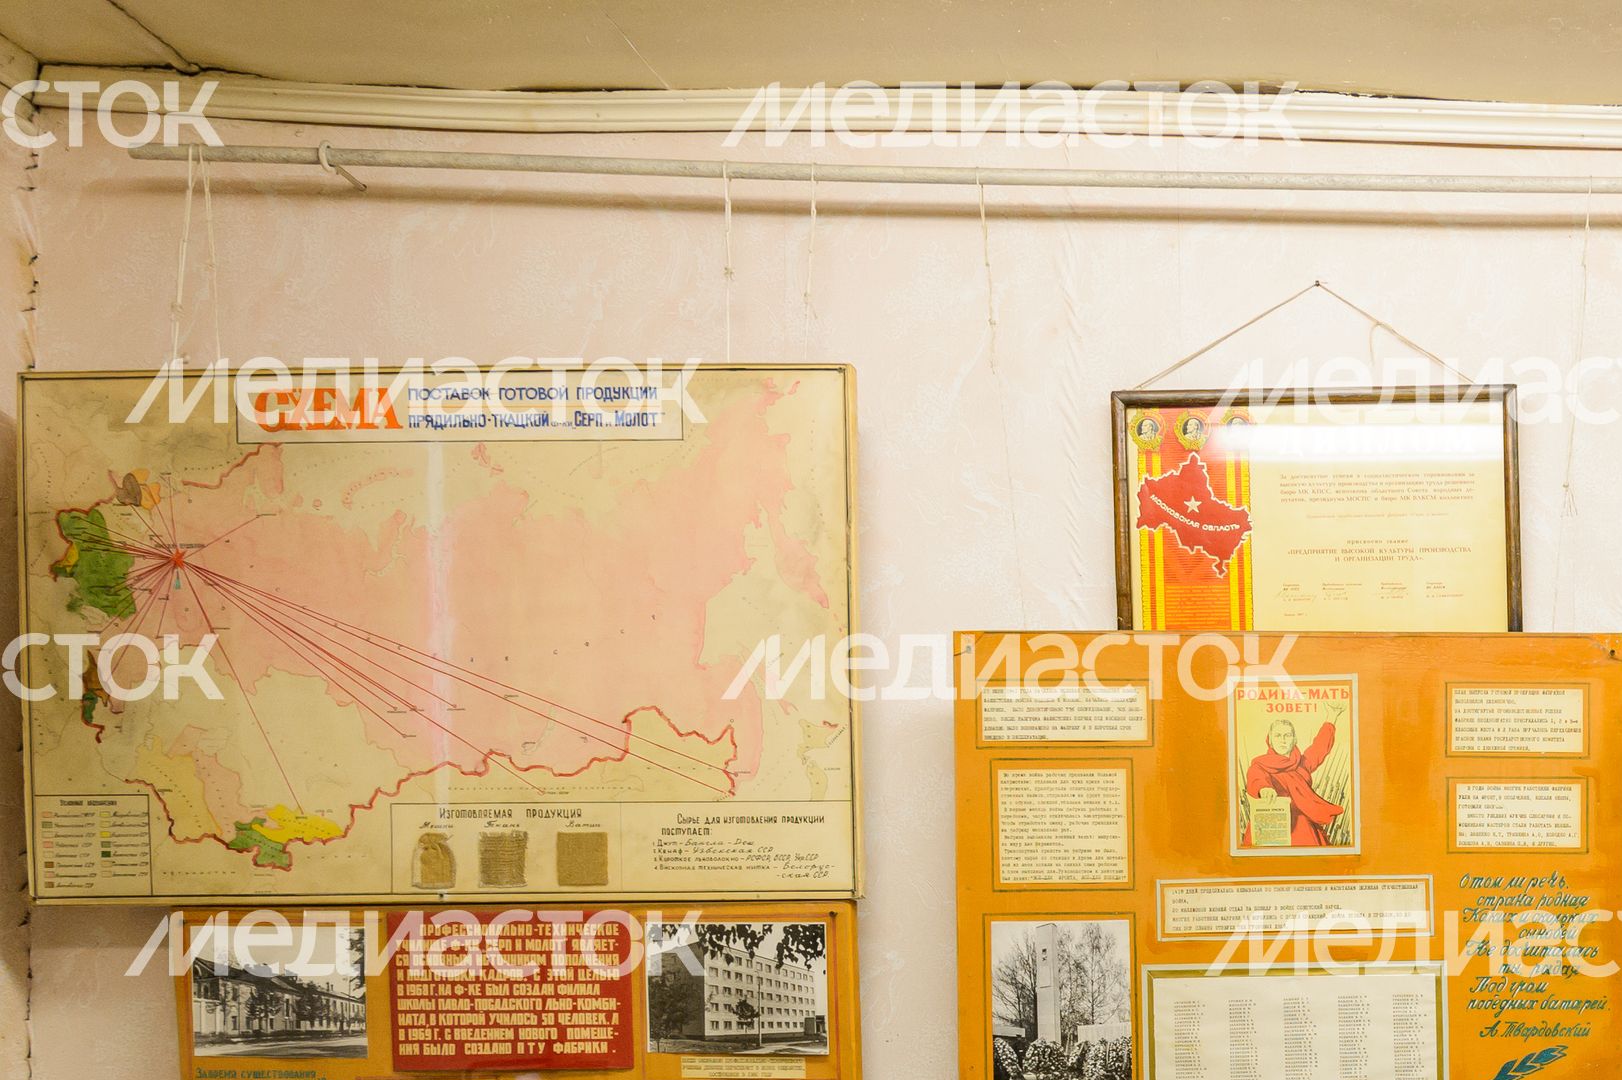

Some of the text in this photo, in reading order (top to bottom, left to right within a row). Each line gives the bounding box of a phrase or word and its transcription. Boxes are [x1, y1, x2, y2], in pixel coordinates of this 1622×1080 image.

[408, 386, 658, 401] ПОСТАВОК ГОТОВОЙ ПРОДУКЦИИ
[256, 388, 403, 431] СХЕМА
[1150, 494, 1200, 528] МОСКОВСКАЯ
[1237, 688, 1349, 700] РОДИНА-МАТЬ
[1266, 703, 1318, 713] ЗОВЕТ!
[1477, 891, 1590, 910] страна родная
[486, 983, 509, 996] БЫЛ
[513, 983, 554, 996] СОЗДАН
[558, 983, 600, 996] ФИЛИАЛ
[1470, 976, 1508, 994] Под
[397, 998, 435, 1010] ШКОЛЫ
[1467, 994, 1538, 1017] победных
[439, 1011, 485, 1025] КОТОРОЙ
[489, 1013, 538, 1025] УЧИЛОСЬ
[542, 1013, 554, 1025] 50
[558, 1013, 609, 1025] ЧЕЛОВЕК.
[408, 1028, 432, 1041] 1969
[454, 1028, 514, 1040] ВВЕДЕНИЕМ
[519, 1028, 557, 1040] НОВОГО
[1500, 1020, 1591, 1042] Твардовский
[399, 1043, 420, 1056] НИЯ
[423, 1043, 456, 1056] БЫЛО
[464, 1043, 512, 1055] СОЗДАНО
[553, 1042, 608, 1055] ФАБРИКИ
